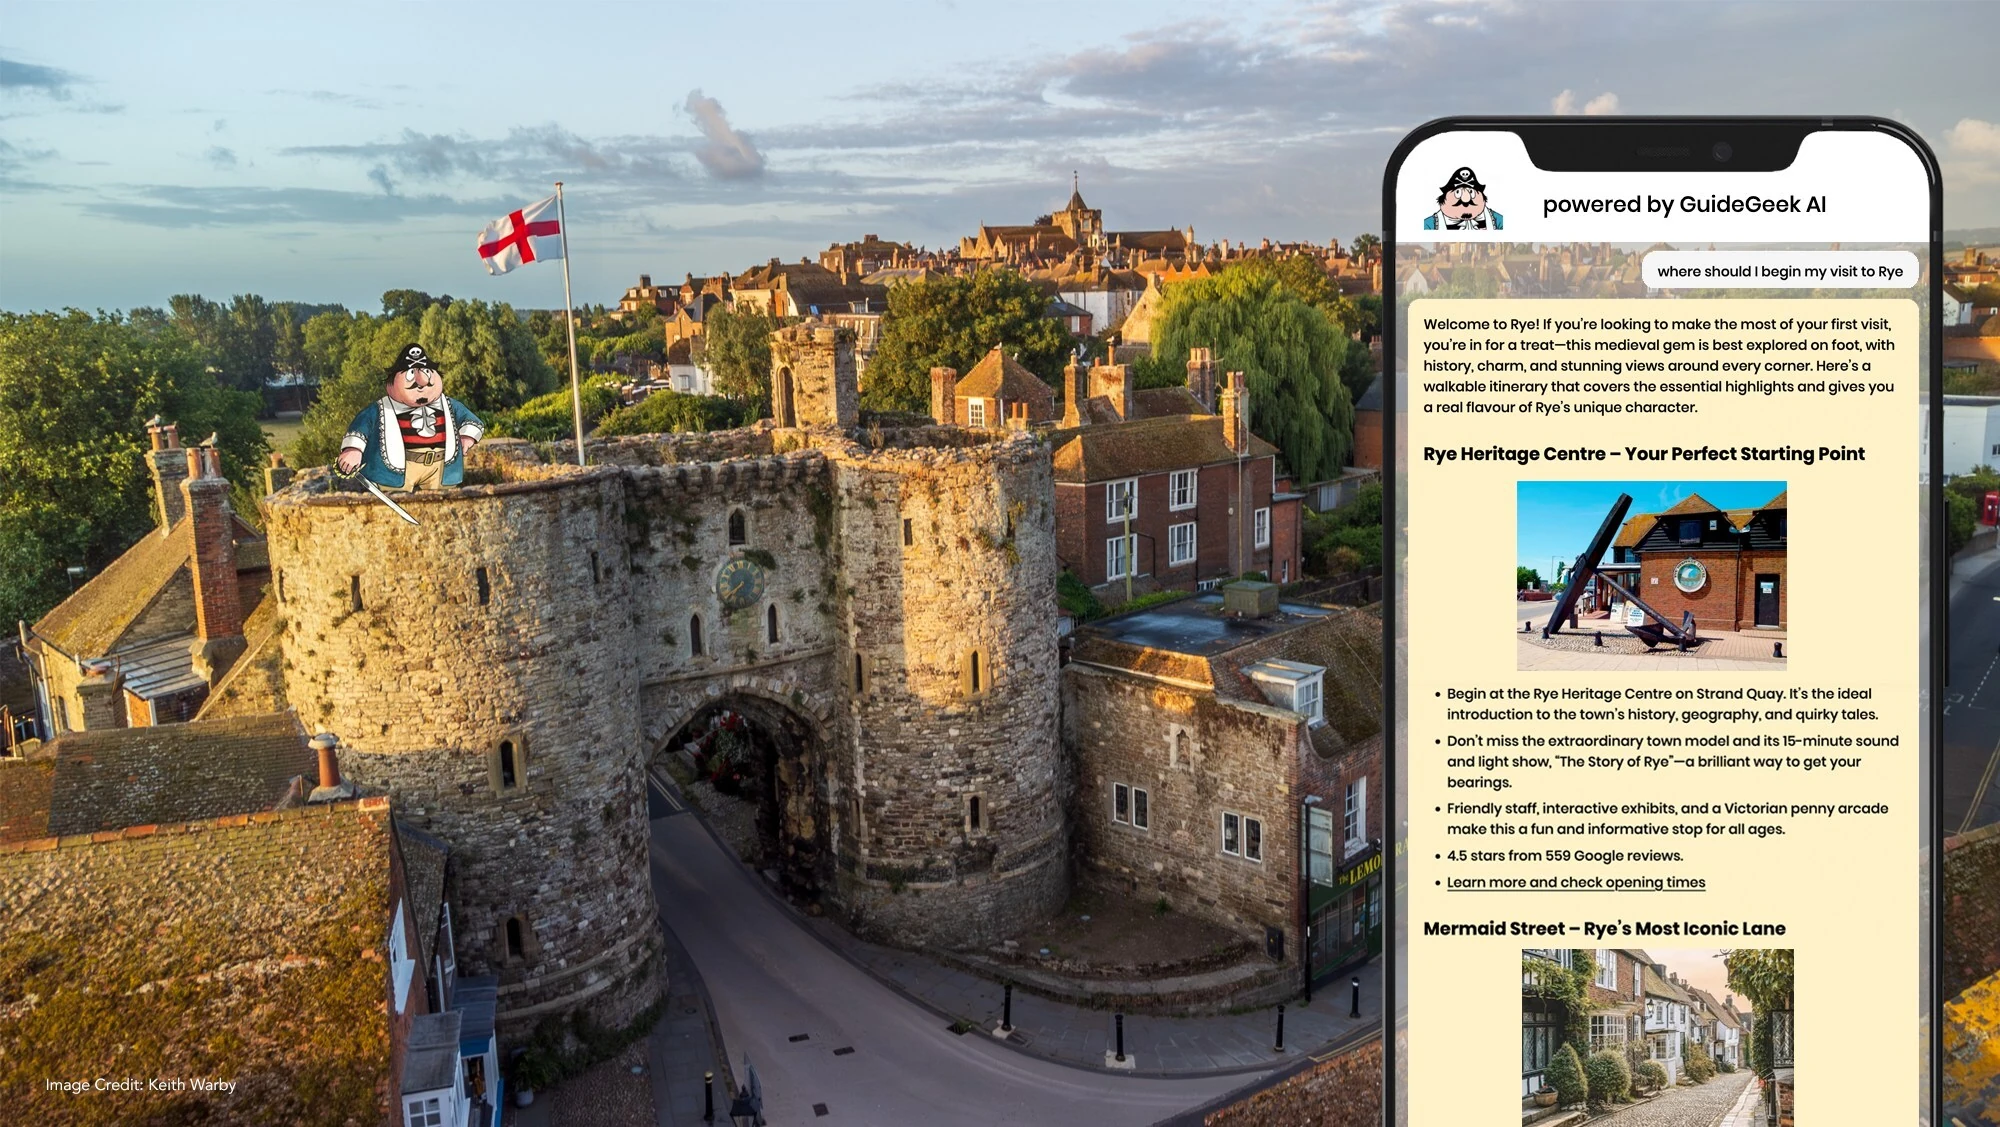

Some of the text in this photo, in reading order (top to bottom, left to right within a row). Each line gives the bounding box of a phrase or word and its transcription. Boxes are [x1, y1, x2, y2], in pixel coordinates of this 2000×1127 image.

[1543, 194, 1826, 219] powered by GuideGeek AI
[1657, 264, 1904, 281] where should I begin my visit to Rye
[1423, 318, 1490, 330] Welcome
[1492, 318, 1508, 330] to
[1510, 318, 1540, 334] Rye!
[1543, 317, 1552, 330] If
[1600, 317, 1651, 334] looking
[1653, 318, 1669, 330] to
[1671, 318, 1712, 330] make
[1713, 318, 1738, 330] the
[1740, 318, 1777, 330] most
[1779, 317, 1794, 330] of
[1796, 320, 1829, 334] your
[1830, 317, 1858, 330] first
[1860, 317, 1892, 332] visit,
[1469, 338, 1482, 351] in
[1484, 338, 1505, 351] for
[1507, 341, 1517, 351] a
[1594, 338, 1660, 351] medieval
[1662, 341, 1696, 355] gem
[1698, 338, 1710, 351] is
[1712, 338, 1744, 351] best
[1746, 338, 1808, 355] explored
[1810, 341, 1829, 351] on
[1831, 338, 1863, 353] foot,
[1865, 338, 1895, 351] with
[1423, 359, 1475, 375] history,
[1477, 359, 1527, 374] charm,
[1529, 359, 1558, 372] and
[1560, 359, 1622, 376] stunning
[1625, 359, 1665, 372] views
[1667, 359, 1719, 372] around
[1721, 362, 1762, 375] every
[1764, 362, 1814, 372] corner.
[1861, 362, 1871, 372] a
[1423, 379, 1895, 396] walkable itinerary that covers the essential highlights and gives you
[1423, 403, 1433, 413] a
[1436, 401, 1463, 413] real
[1465, 400, 1516, 413] flavour
[1518, 400, 1533, 413] of
[1573, 400, 1623, 417] unique
[1625, 401, 1698, 413] character.
[1423, 446, 1458, 466] Rye
[1461, 445, 1541, 466] Heritage
[1543, 446, 1607, 461] Centre
[1624, 446, 1669, 461] Your
[1671, 445, 1738, 461] Perfect
[1740, 445, 1815, 466] Starting
[1818, 445, 1866, 461] Point
[1447, 687, 1487, 703] Begin
[1489, 688, 1505, 700] at
[1506, 687, 1531, 700] the
[1533, 688, 1559, 703] Rye
[1561, 687, 1622, 703] Heritage
[1624, 688, 1673, 700] Centre
[1675, 690, 1694, 700] on
[1696, 687, 1744, 700] Strand
[1746, 687, 1787, 703] Quay.
[1811, 687, 1835, 700] the
[1837, 687, 1872, 700] ideal
[1447, 707, 1533, 721] introduction
[1535, 709, 1551, 721] to
[1553, 708, 1577, 721] the
[1628, 707, 1679, 724] history,
[1681, 708, 1762, 724] geography,
[1764, 708, 1793, 721] and
[1795, 707, 1839, 724] quirky
[1840, 708, 1879, 721] tales.
[1486, 734, 1519, 747] miss
[1521, 735, 1546, 747] the
[1548, 734, 1644, 751] extraordinary
[1646, 735, 1682, 747] town
[1684, 734, 1730, 747] model
[1732, 734, 1761, 747] and
[1763, 734, 1780, 747] its
[1782, 734, 1853, 747] 15-minute
[1855, 734, 1899, 747] sound
[1447, 775, 1513, 792] bearings.
[1447, 801, 1889, 818] Friendly staff, interactive exhibits, and a Victorian penny arcade
[1447, 822, 1786, 839] make this a fun and informative stop for all ages.
[1447, 849, 1684, 865] 4.5 stars from 559 Google reviews.
[1349, 853, 1383, 886] LEMO
[1447, 875, 1706, 890] Learn more and check opening times
[1423, 919, 1507, 936] Mermaid
[1509, 921, 1566, 936] Street
[1635, 921, 1681, 936] Most
[1683, 919, 1739, 936] Iconic
[1742, 921, 1787, 936] Lane
